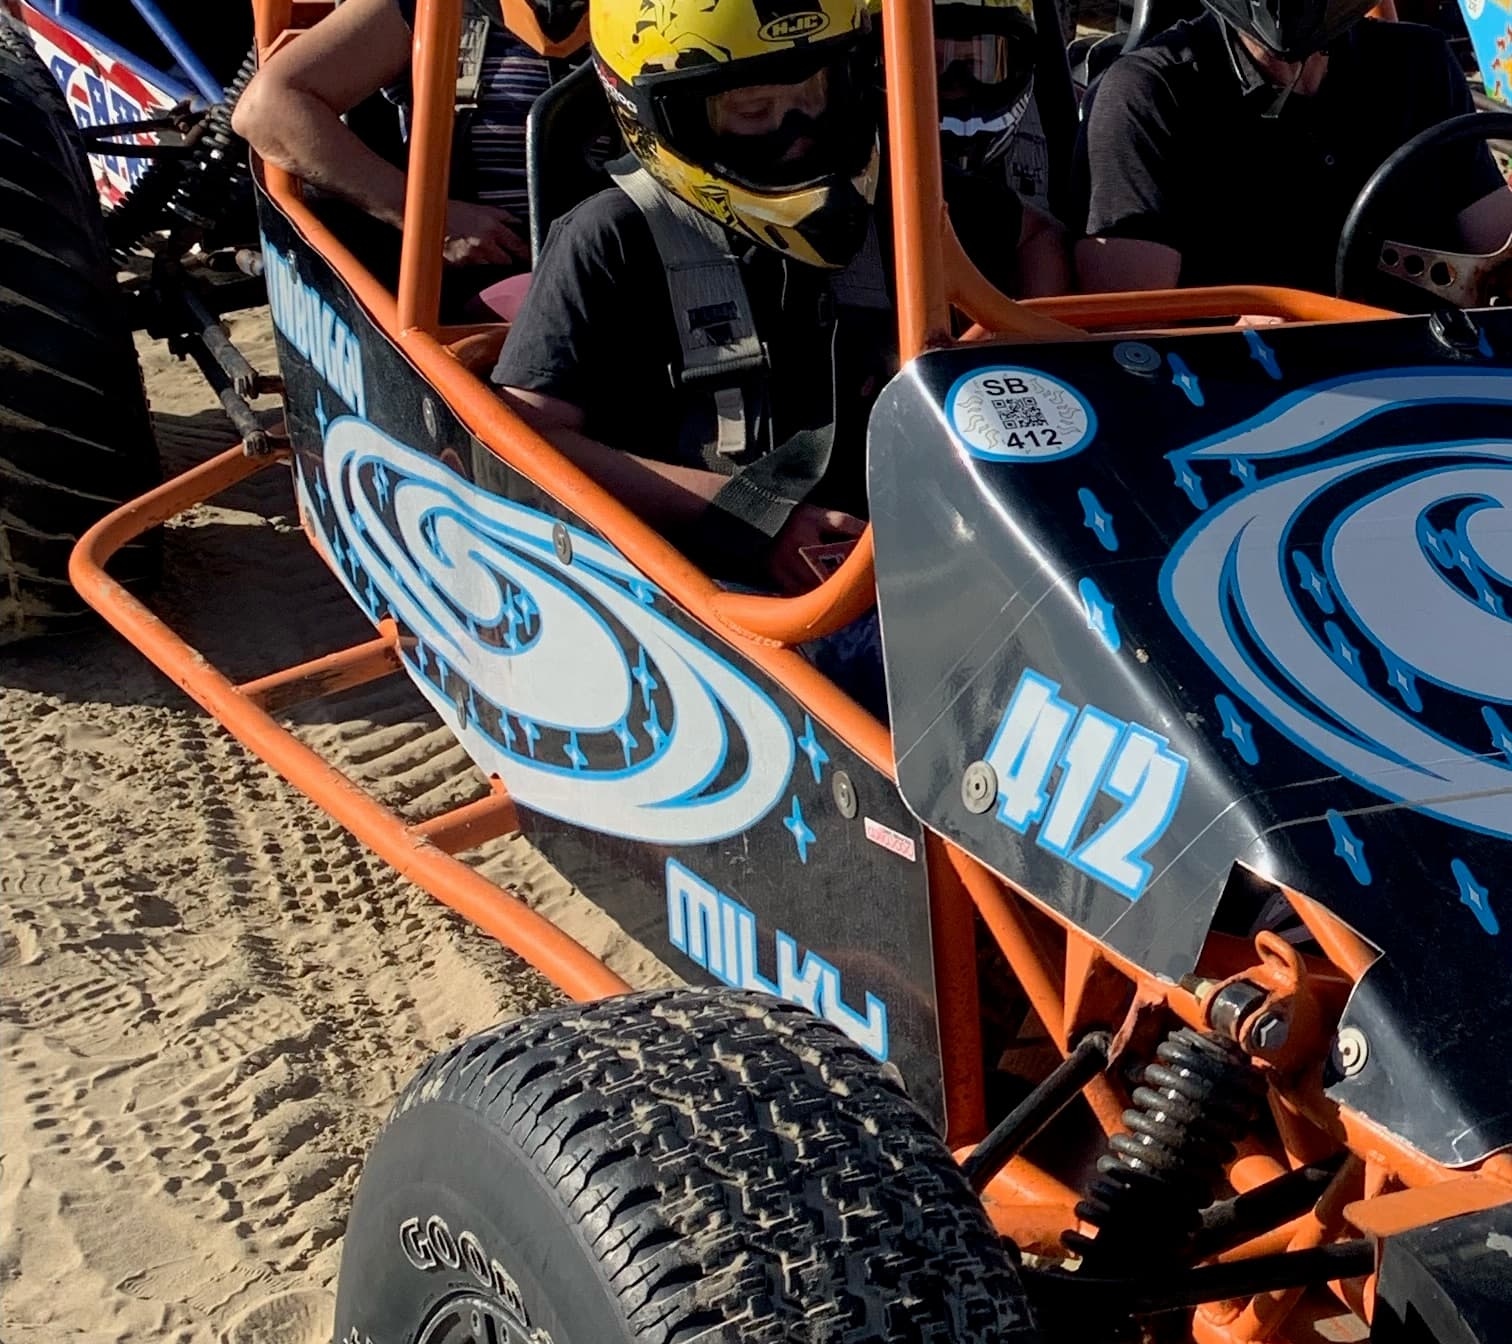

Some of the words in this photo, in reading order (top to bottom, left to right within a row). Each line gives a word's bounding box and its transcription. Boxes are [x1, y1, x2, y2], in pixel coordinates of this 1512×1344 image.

[769, 15, 822, 39] HJC
[983, 377, 1029, 396] SB
[1007, 428, 1063, 449] 412
[983, 666, 1190, 903] 412
